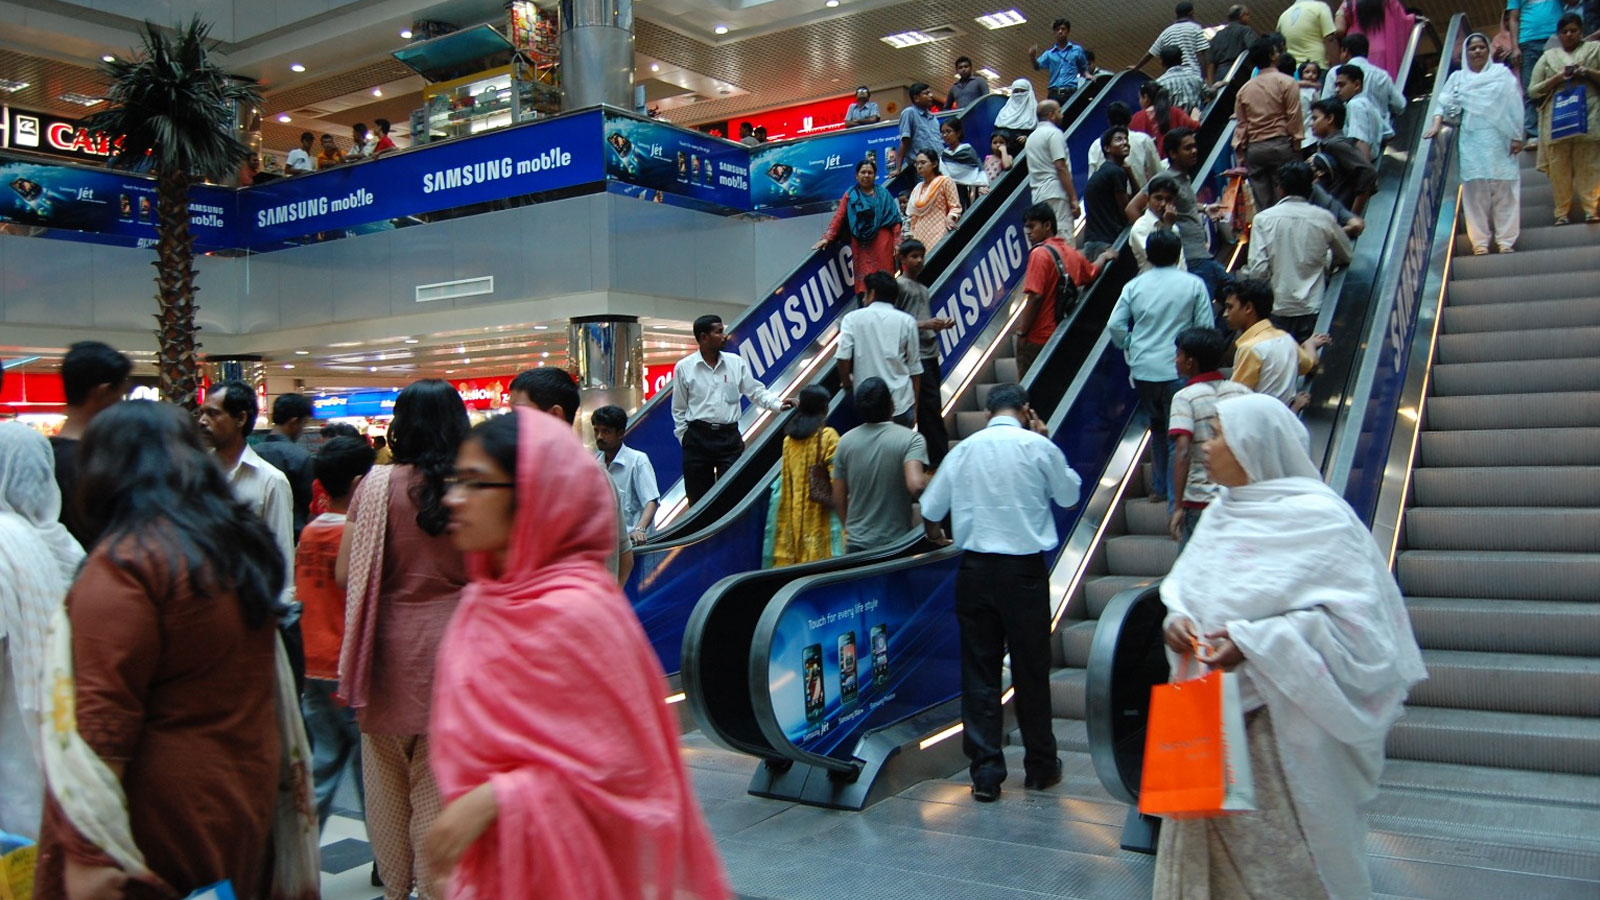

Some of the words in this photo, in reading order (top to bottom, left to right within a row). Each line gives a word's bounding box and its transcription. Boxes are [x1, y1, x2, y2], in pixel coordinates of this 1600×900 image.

[423, 158, 512, 193] SAMSUNG
[719, 161, 747, 176] SAMSUNG
[188, 203, 224, 215] AMSUNG
[257, 197, 328, 228] SAMSUNG
[936, 224, 1022, 367] MSUNG
[738, 245, 855, 378] AMSUNG
[808, 615, 827, 630] Touch
